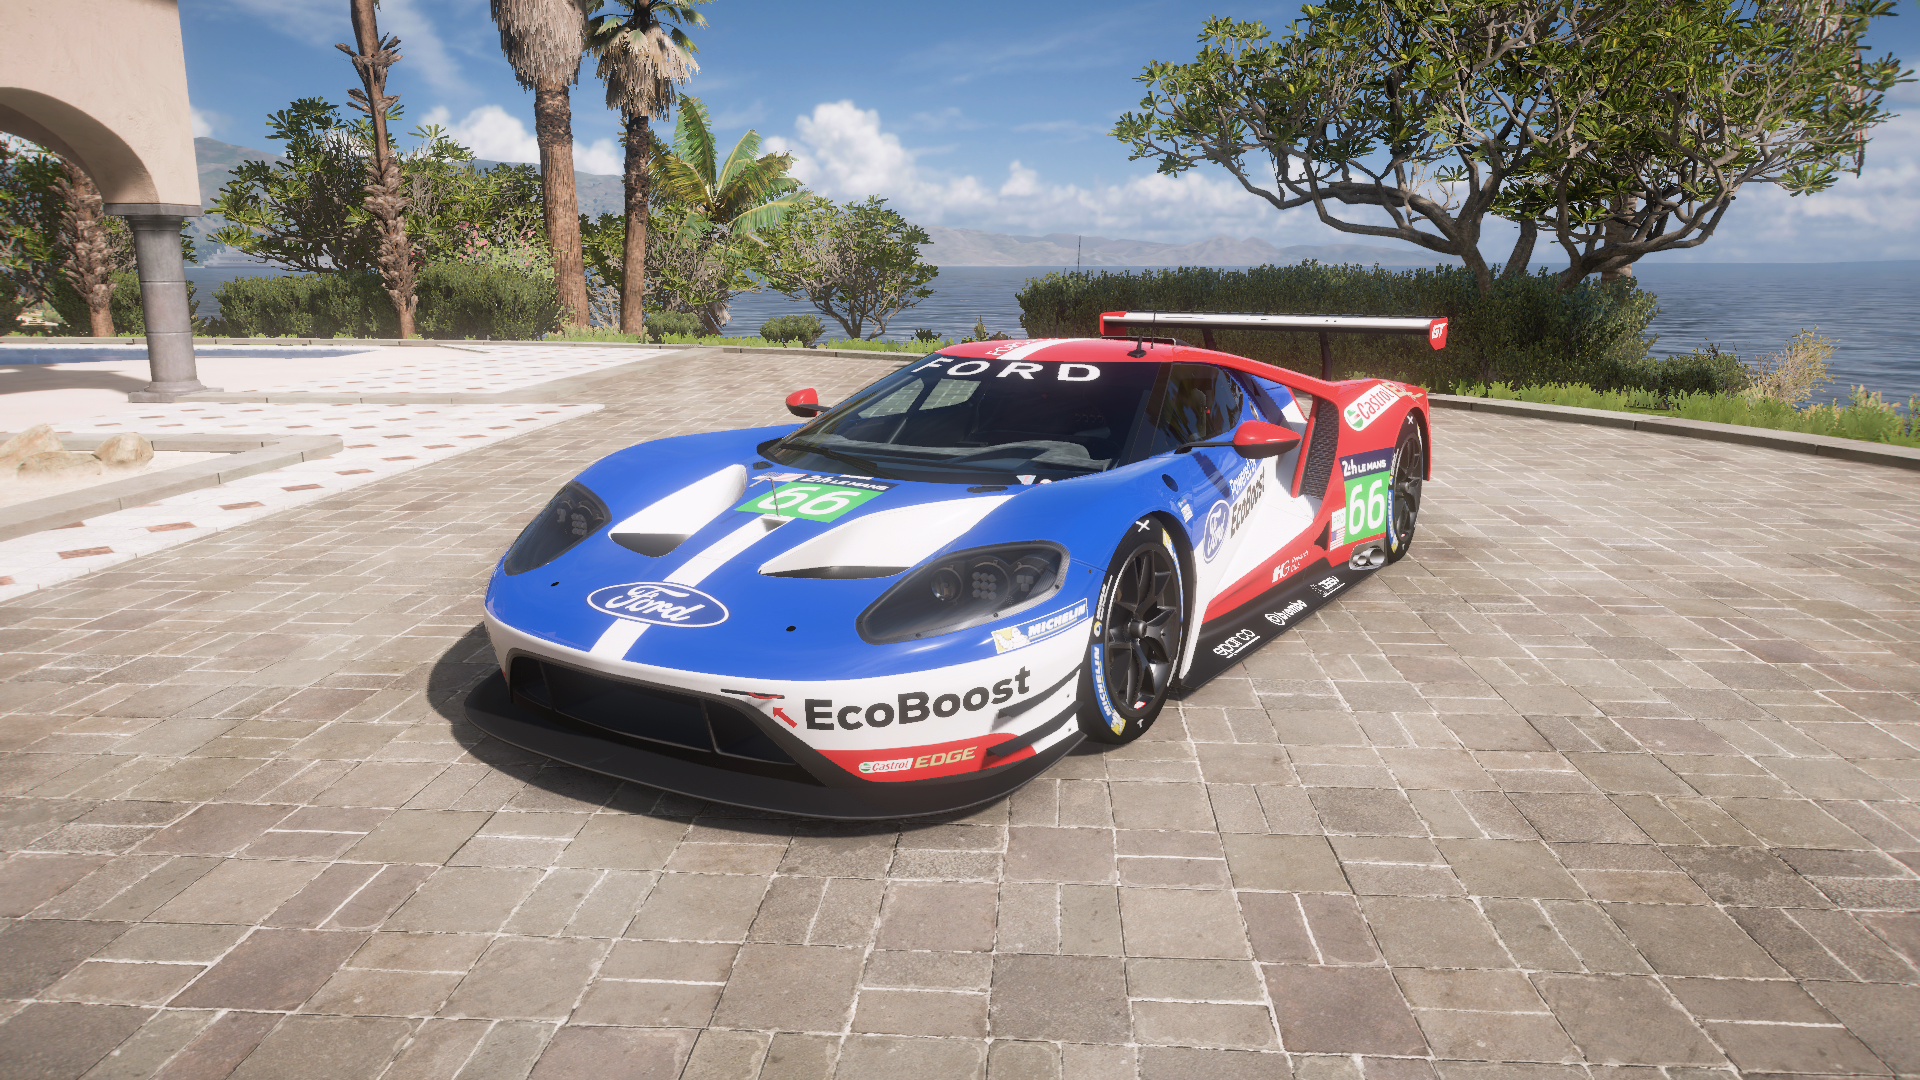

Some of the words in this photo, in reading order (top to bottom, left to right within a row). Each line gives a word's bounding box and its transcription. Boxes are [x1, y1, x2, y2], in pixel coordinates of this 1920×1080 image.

[911, 357, 1101, 381] FORD
[1356, 387, 1395, 420] Castrol
[1357, 463, 1367, 473] LE
[1366, 459, 1387, 471] MANS
[757, 486, 862, 516] 66
[847, 481, 890, 491] MANS
[1230, 465, 1265, 540] EcoBoost
[1348, 478, 1386, 536] 66
[1207, 507, 1227, 556] Ford
[604, 585, 706, 621] Ford
[1273, 599, 1308, 621] brembo
[1027, 603, 1086, 637] MICHELIN
[1212, 628, 1256, 656] sparco
[804, 665, 1031, 731] EcoBoost
[1093, 646, 1112, 717] MICHELIN
[871, 760, 909, 772] Castrol
[913, 746, 978, 769] EDGE
